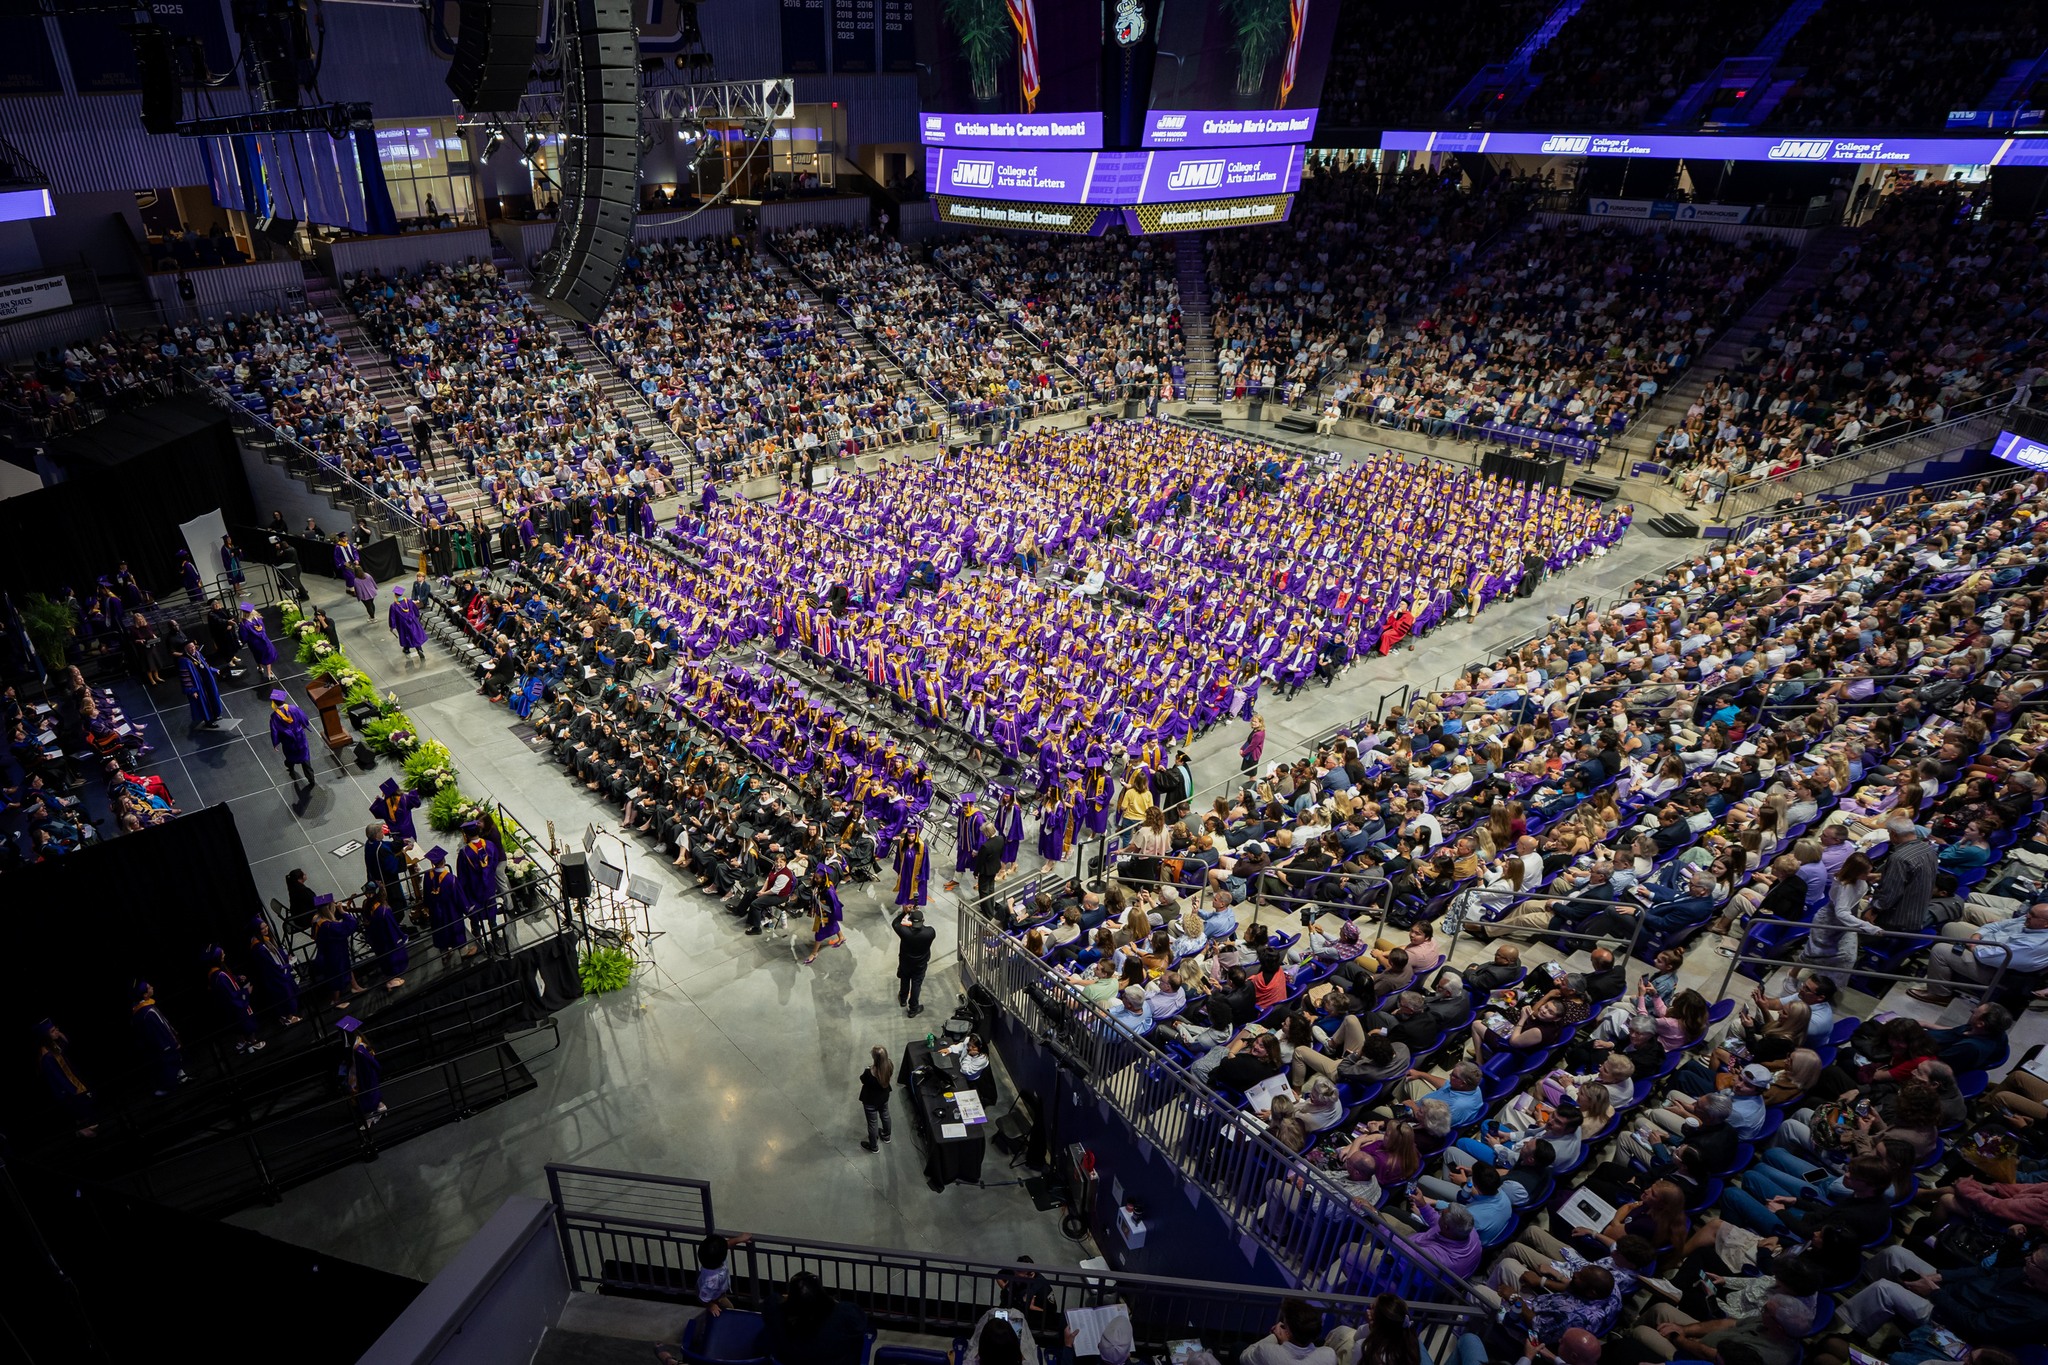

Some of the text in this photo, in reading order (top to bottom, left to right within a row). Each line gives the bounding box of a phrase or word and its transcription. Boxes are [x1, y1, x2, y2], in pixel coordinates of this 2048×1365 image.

[152, 4, 184, 15] 2025
[837, 32, 854, 40] 2025
[955, 121, 1085, 136] Christine Marie Carson Donati
[1157, 115, 1186, 130] JMU
[1203, 117, 1310, 134] Christine Marie Carson Donati
[1542, 136, 1591, 154] JMU
[1593, 138, 1629, 147] College of
[1835, 142, 1883, 152] College of
[1770, 140, 1833, 160] JMU
[1875, 152, 1910, 160] Letters
[998, 166, 1038, 177] College of
[1228, 161, 1261, 174] College of
[952, 161, 994, 188] JMU
[1169, 160, 1225, 189] JMU
[1226, 172, 1276, 184] Arts and Letters
[998, 178, 1065, 188] Arts and Letters
[950, 203, 1073, 226] Atlantic Union Bank Center
[1160, 204, 1276, 225] Atlantic Union Bank Center
[34, 282, 49, 290] Energy
